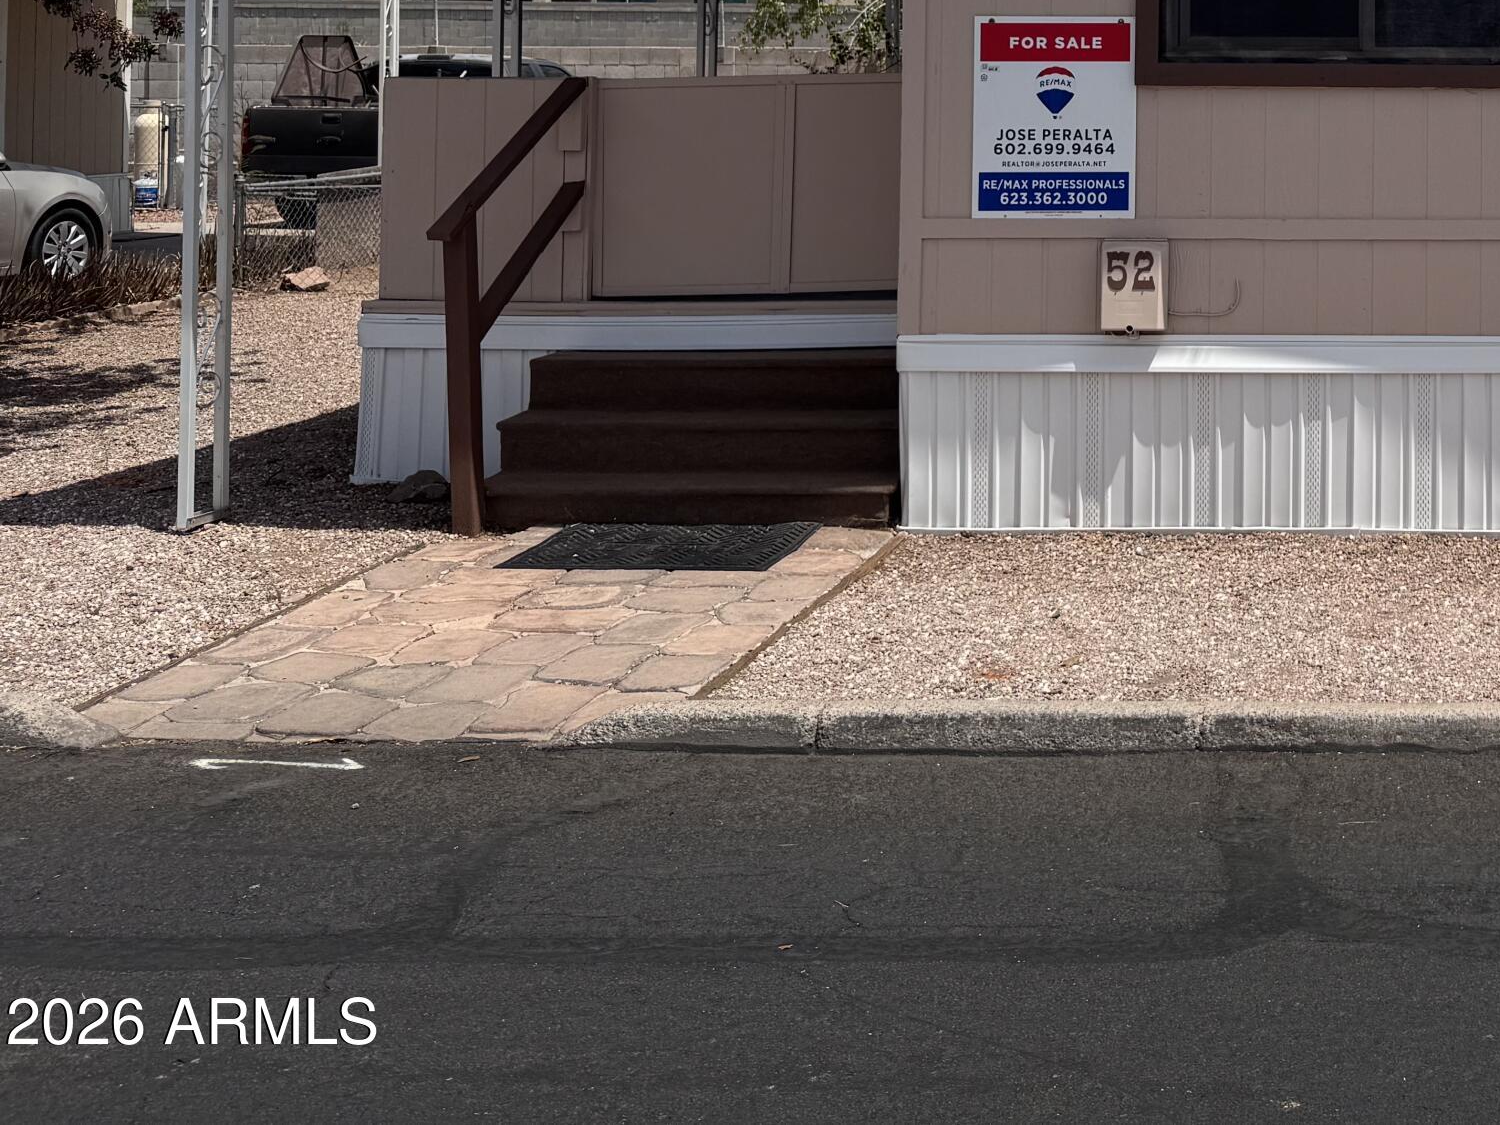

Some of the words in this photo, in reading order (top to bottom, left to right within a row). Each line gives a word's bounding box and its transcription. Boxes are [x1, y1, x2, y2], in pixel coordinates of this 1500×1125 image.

[1009, 37, 1047, 49] FOR
[1055, 37, 1102, 49] SALE
[1039, 78, 1072, 88] RE/MAX
[996, 129, 1036, 141] JOSE
[1042, 129, 1113, 141] PERALTA
[993, 143, 1115, 155] 602.699.9464
[983, 179, 1028, 190] RE/MAX
[1032, 179, 1125, 190] PROFESSIONALS
[1000, 192, 1108, 205] 623.362.3000
[1106, 250, 1156, 292] 52
